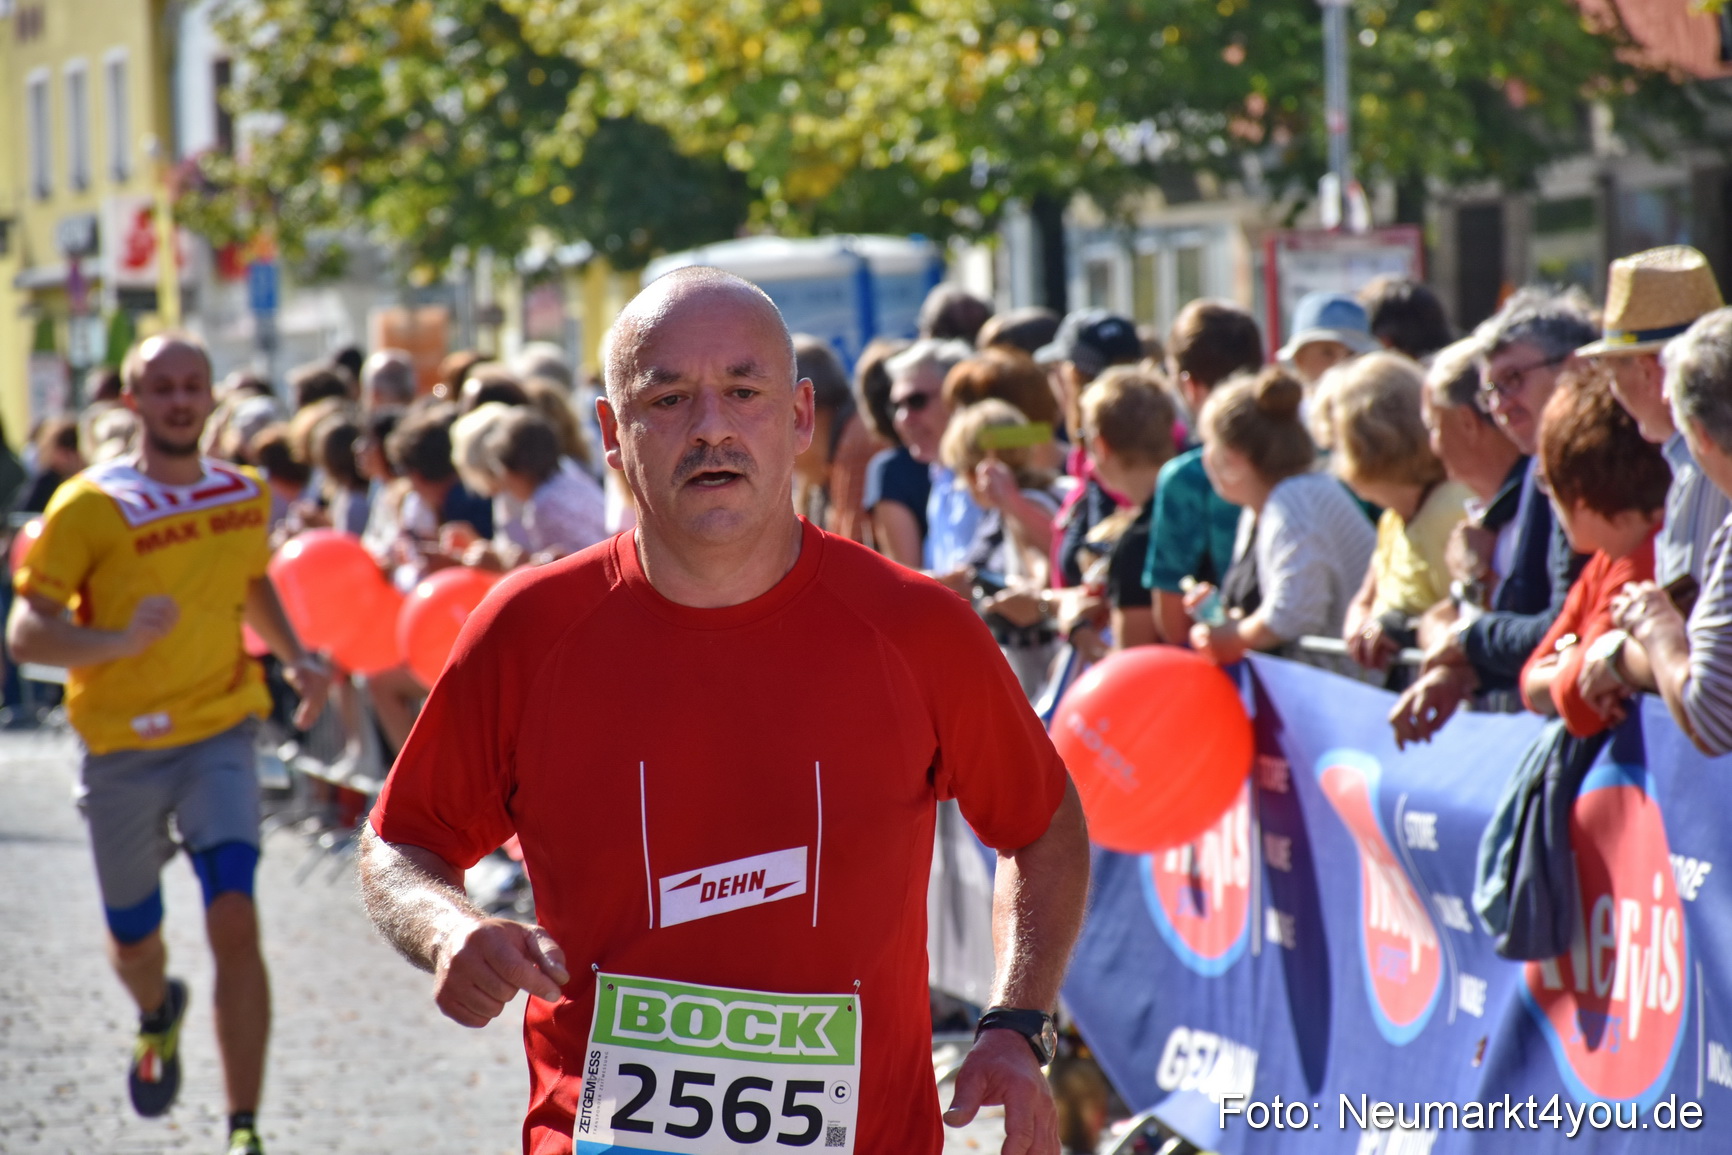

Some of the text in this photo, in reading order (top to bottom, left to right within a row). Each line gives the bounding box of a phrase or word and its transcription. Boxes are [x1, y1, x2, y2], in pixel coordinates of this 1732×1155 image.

[134, 521, 199, 555] MAX
[700, 869, 766, 903] DEHN
[613, 988, 837, 1054] BOCK
[599, 1051, 609, 1091] ZEITMESSUNG
[610, 1063, 825, 1147] 2565
[834, 1085, 846, 1098] C
